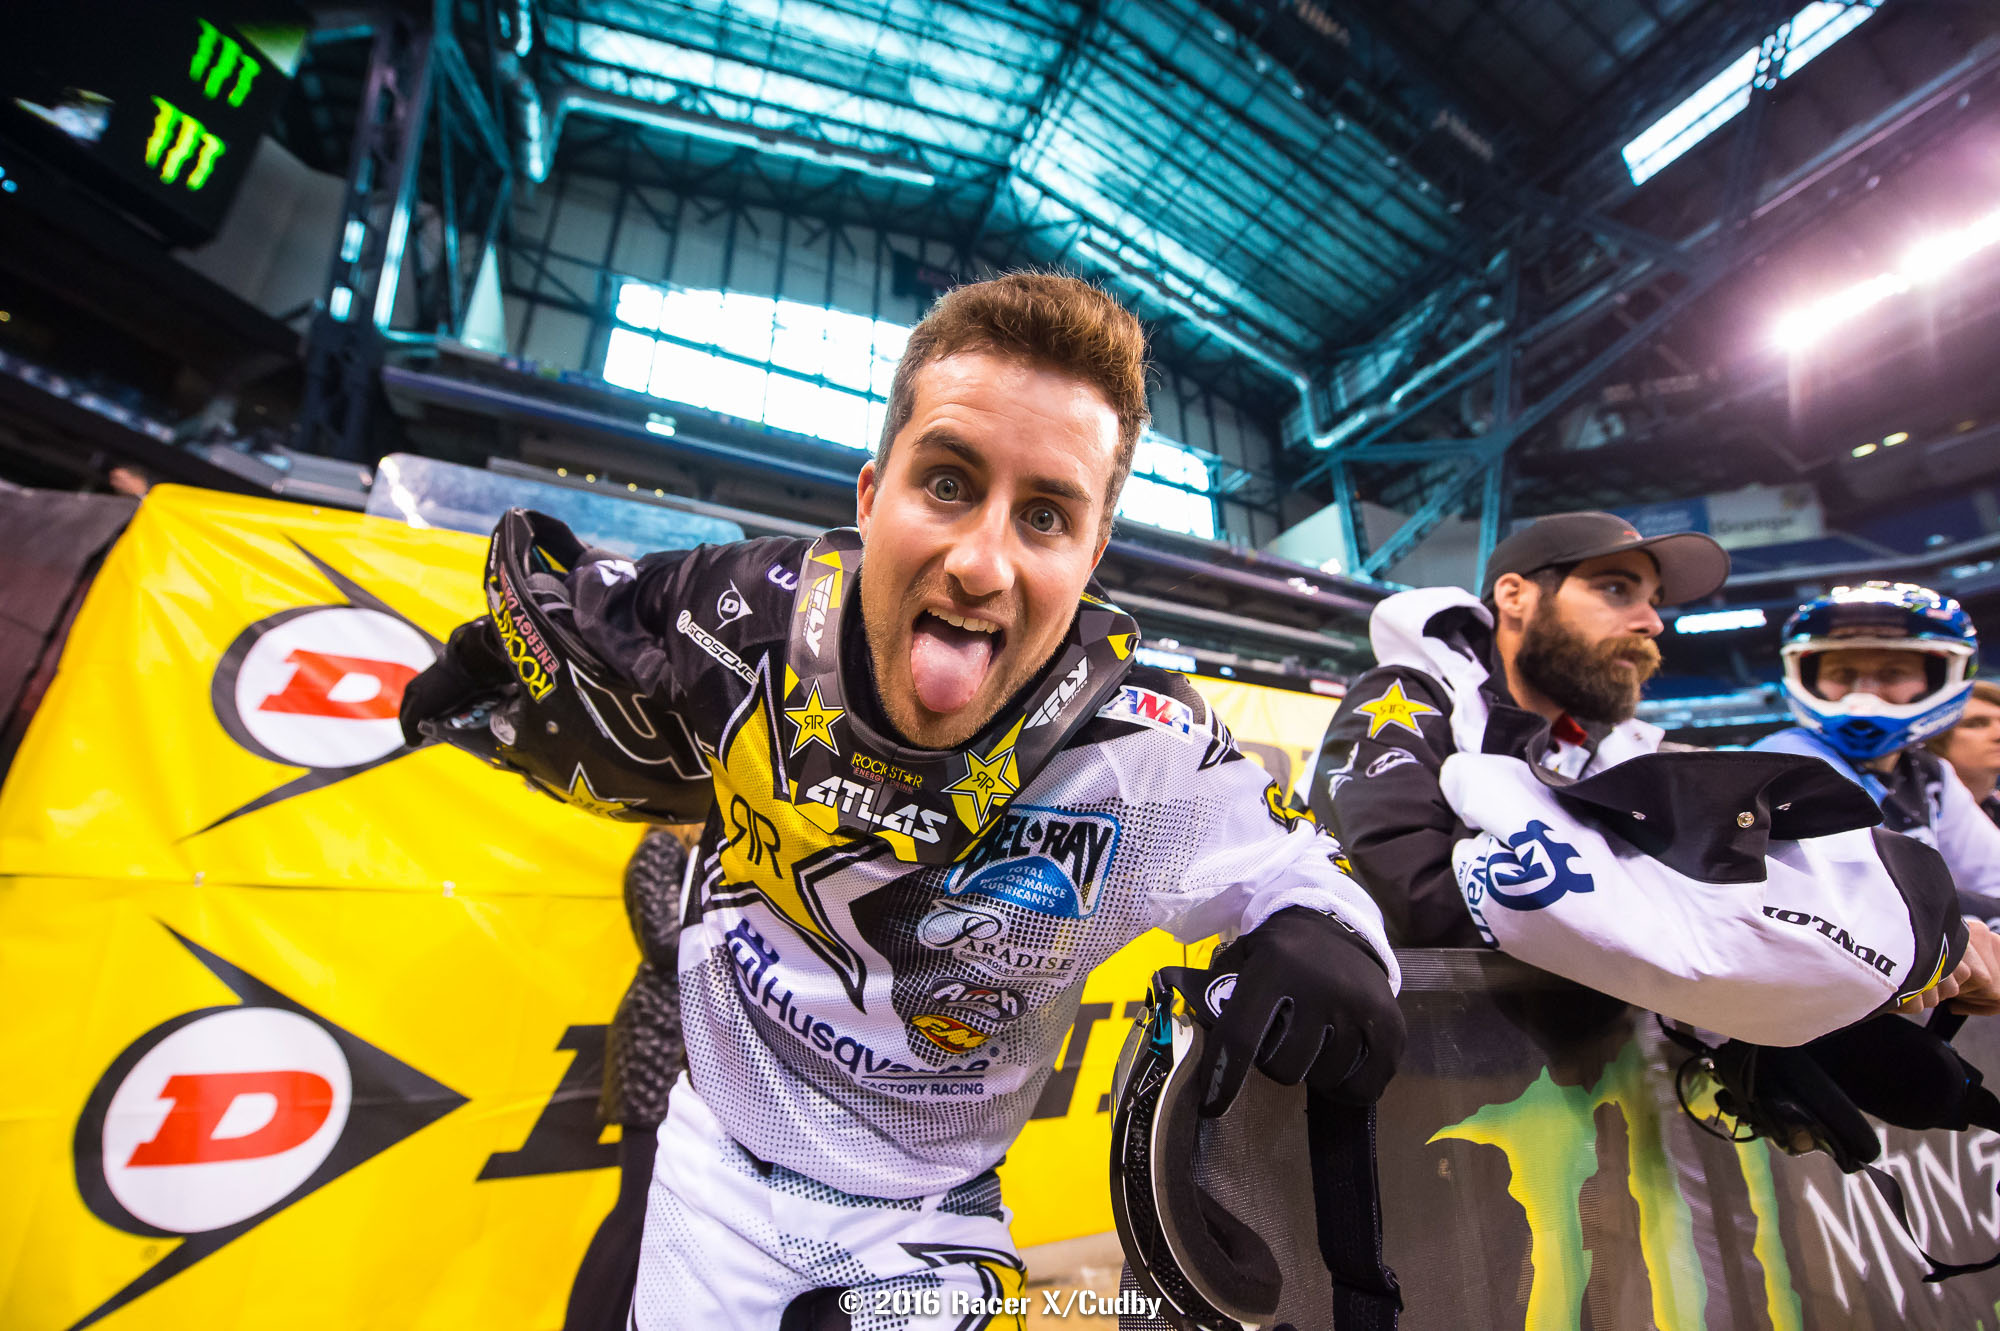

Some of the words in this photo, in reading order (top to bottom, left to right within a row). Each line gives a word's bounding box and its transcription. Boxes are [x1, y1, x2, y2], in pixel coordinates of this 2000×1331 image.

[687, 622, 759, 685] SCOSCHE
[805, 775, 948, 845] ATLAS
[125, 1069, 334, 1169] D
[930, 1082, 985, 1096] RACING
